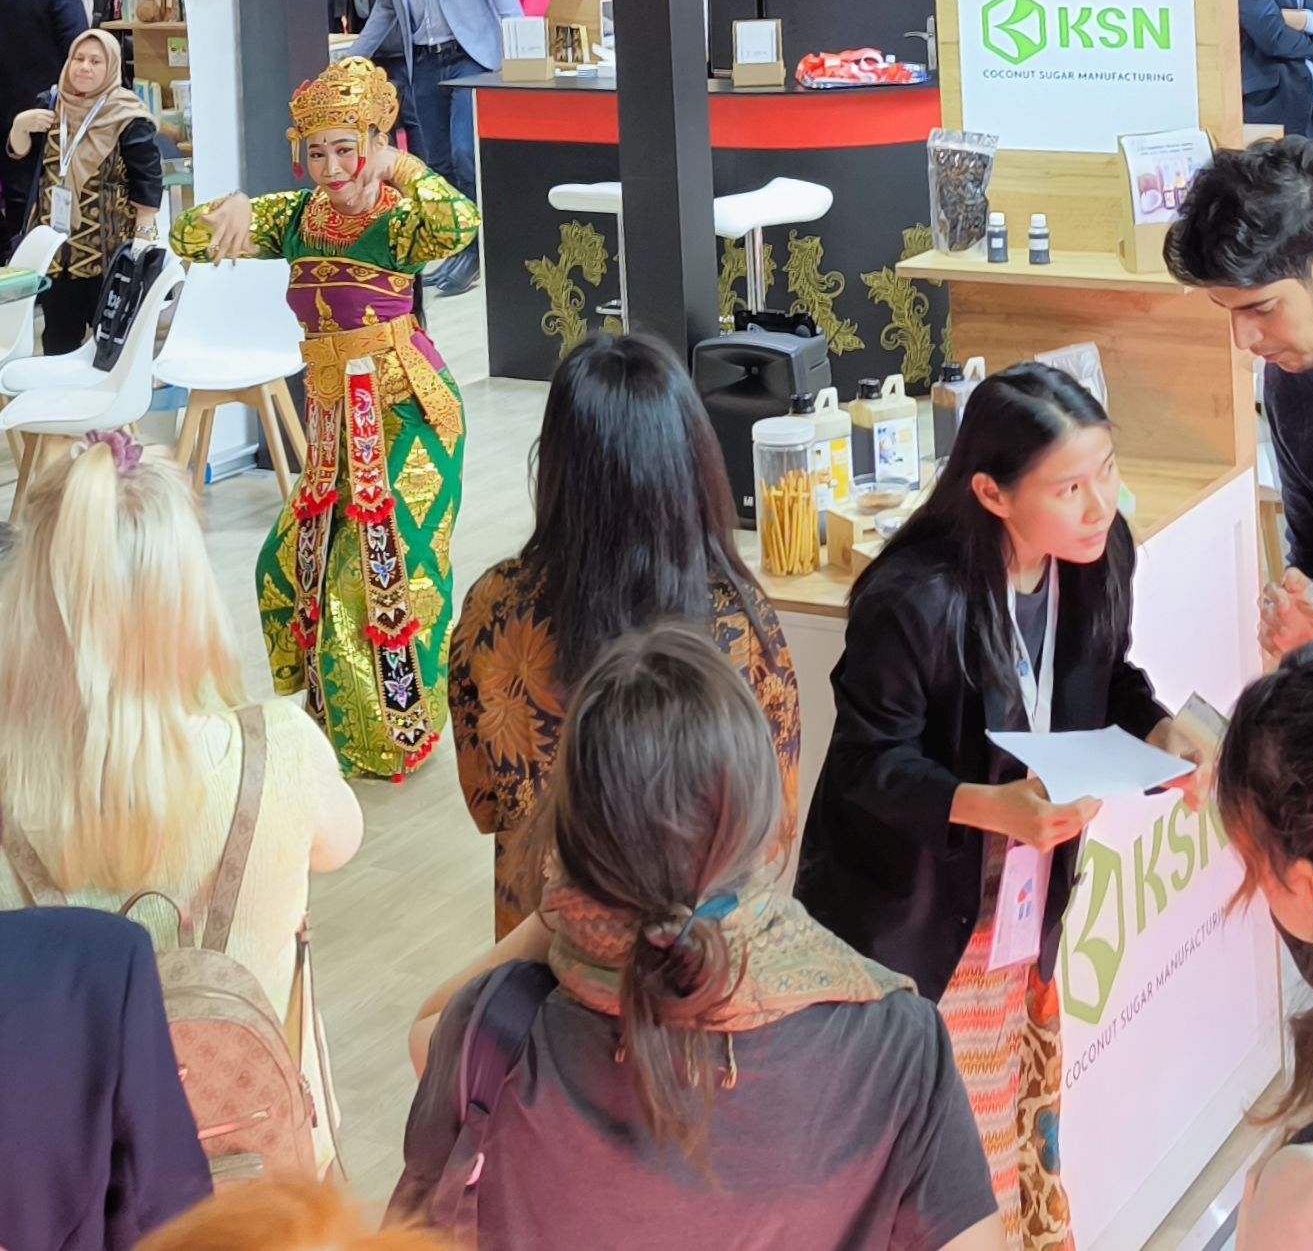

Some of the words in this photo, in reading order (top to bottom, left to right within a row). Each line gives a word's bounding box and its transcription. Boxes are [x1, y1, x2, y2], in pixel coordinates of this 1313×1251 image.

[1058, 6, 1172, 50] KSN
[983, 69, 1036, 79] COCONUT
[1039, 70, 1074, 81] SUGAR
[1078, 71, 1175, 83] MANUFACTURING
[1065, 1019, 1119, 1090] COCONUT
[1120, 981, 1155, 1030] SUGAR
